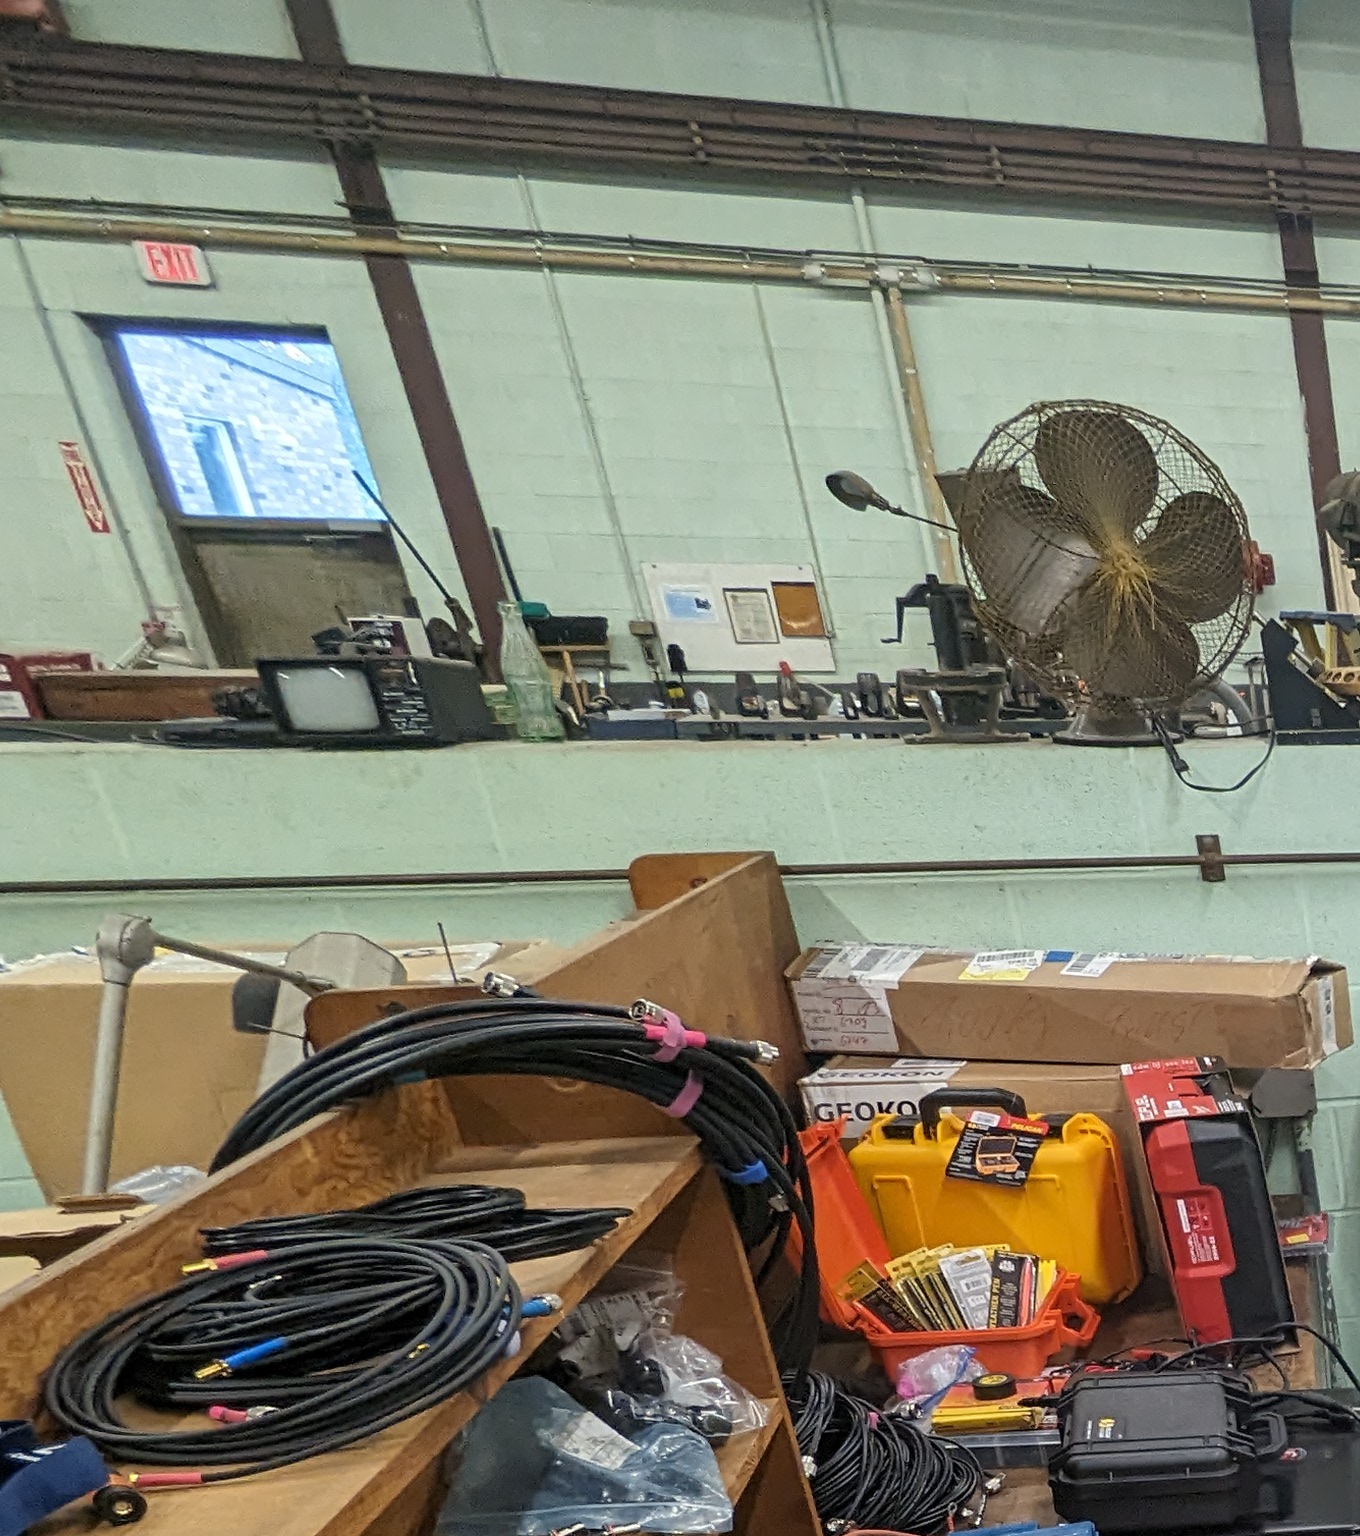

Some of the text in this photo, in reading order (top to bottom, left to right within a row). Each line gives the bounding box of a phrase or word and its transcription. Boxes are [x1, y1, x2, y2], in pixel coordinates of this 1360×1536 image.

[145, 244, 199, 281] EXIT
[817, 1069, 945, 1080] GEOKON
[813, 1100, 922, 1123] GEOKO
[1011, 1122, 1045, 1134] PELICAN
